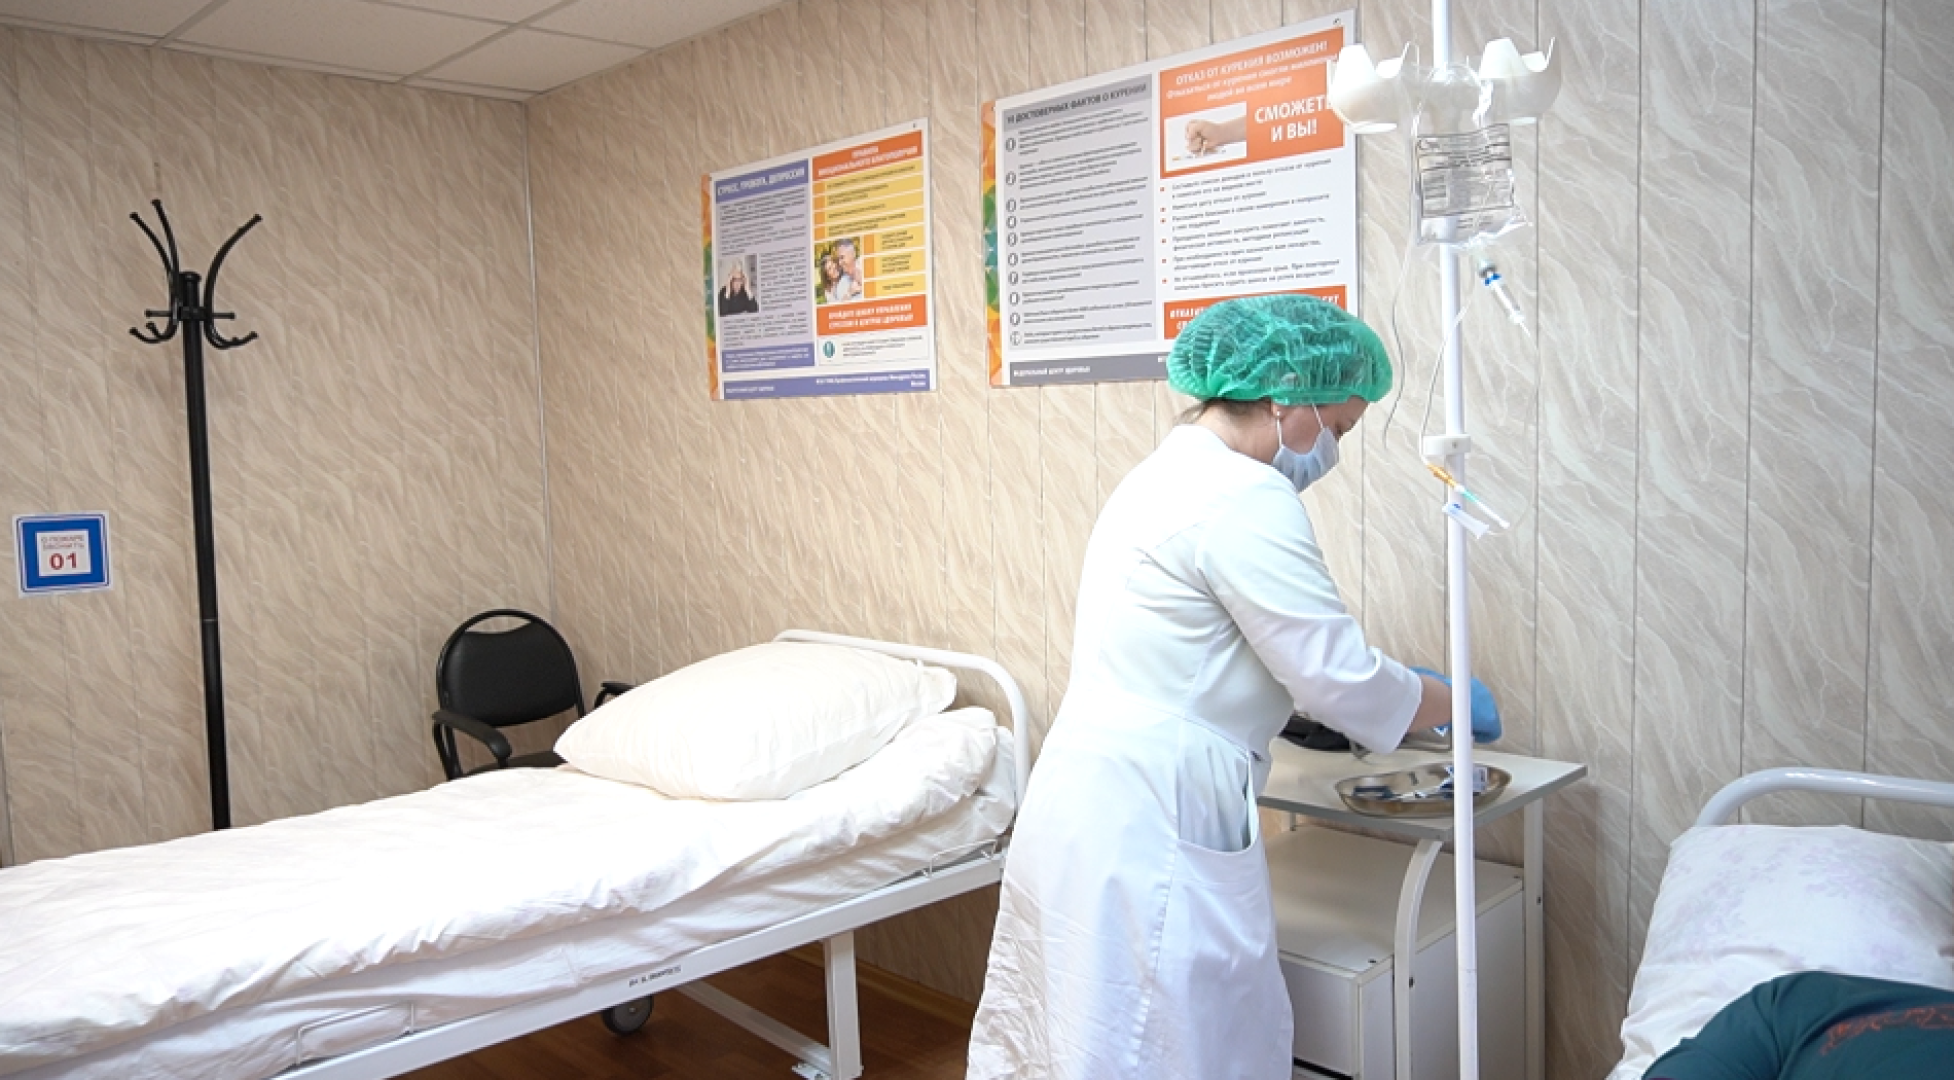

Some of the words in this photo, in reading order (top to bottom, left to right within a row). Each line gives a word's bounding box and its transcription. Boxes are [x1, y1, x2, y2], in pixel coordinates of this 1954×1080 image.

[1176, 69, 1206, 85] ОТКАЗ
[1207, 67, 1219, 78] ОТ
[1220, 55, 1264, 73] КУРЕНИЯ
[1266, 40, 1328, 65] ВОЗМОЖЕН!
[1070, 94, 1101, 109] ФАКТОВ
[1102, 92, 1109, 101] О
[1110, 83, 1147, 99] КУРЕНИИ
[1271, 125, 1282, 142] И
[1287, 118, 1317, 140] ВЫ!
[49, 552, 77, 570] 01
